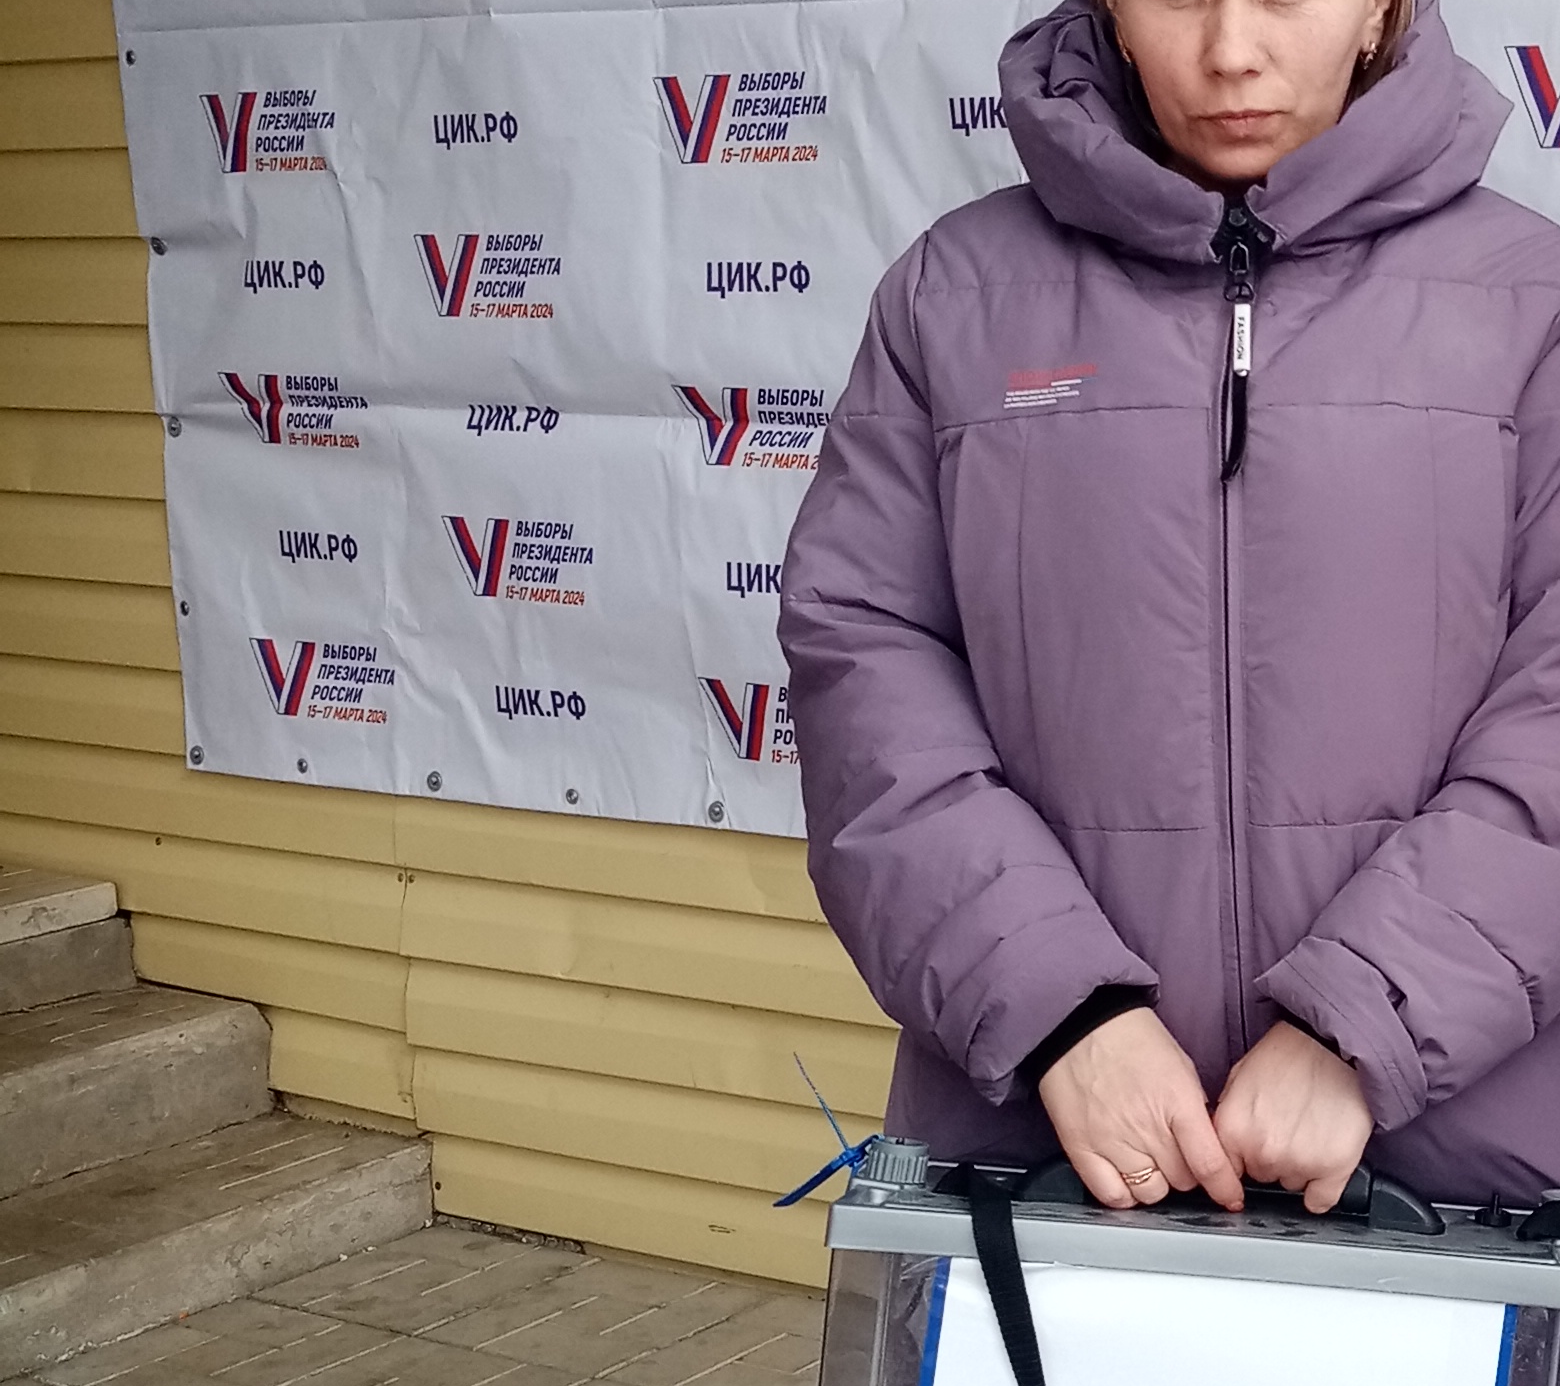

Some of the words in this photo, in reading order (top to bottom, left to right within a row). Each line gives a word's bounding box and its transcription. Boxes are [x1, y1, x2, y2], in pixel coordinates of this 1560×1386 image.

[738, 71, 805, 91] ВЫБОРЫ
[263, 90, 316, 108] ВЫБОРЫ
[732, 96, 827, 118] ПРЕЗИДЕНТА
[949, 97, 1007, 137] ЦИК
[434, 112, 517, 150] ЦИК.РФ
[726, 122, 788, 141] РОССИИ
[255, 135, 304, 152] РОССИИ
[753, 146, 790, 162] МАРТА
[792, 146, 818, 161] 2024
[279, 157, 308, 171] МАРТА
[486, 234, 543, 251] ВЫБОРЫ
[480, 258, 561, 277] ПРЕЗИДЕНТА
[244, 260, 324, 294] ЦИК.РФ
[707, 261, 810, 298] ЦИК.РФ
[474, 281, 525, 298] РОССИИ
[496, 303, 528, 318] МАРТА
[530, 304, 553, 318] 2024
[286, 376, 338, 392] ВЫБОРЫ
[288, 394, 368, 410] ПРЕЗИДЕНТА
[758, 389, 824, 407] ВЫБОРЫ
[287, 413, 333, 429] РОССИИ
[467, 404, 559, 436] ЦИК.РФ
[758, 411, 829, 427] ПРЕЗИДЕ
[311, 434, 338, 447] МАРТА
[340, 435, 359, 448] 2024
[749, 431, 814, 448] РОССИИ
[773, 454, 809, 470] МАРТА
[516, 521, 573, 540] ВЫБОРЫ
[279, 530, 357, 563] ЦИК.РФ
[512, 542, 593, 564] ПРЕЗИДЕНТА
[509, 564, 558, 584] РОССИИ
[726, 562, 781, 598] ЦИК
[529, 588, 560, 603] МАРТА
[562, 591, 584, 605] 2024
[323, 644, 377, 662] ВЫБОРЫ
[317, 664, 395, 685] ПРЕЗИДЕНТА
[311, 685, 363, 703] РОССИИ
[496, 686, 585, 720] ЦИК.РФ
[333, 707, 364, 722] МАРТА
[366, 709, 387, 723] 2024
